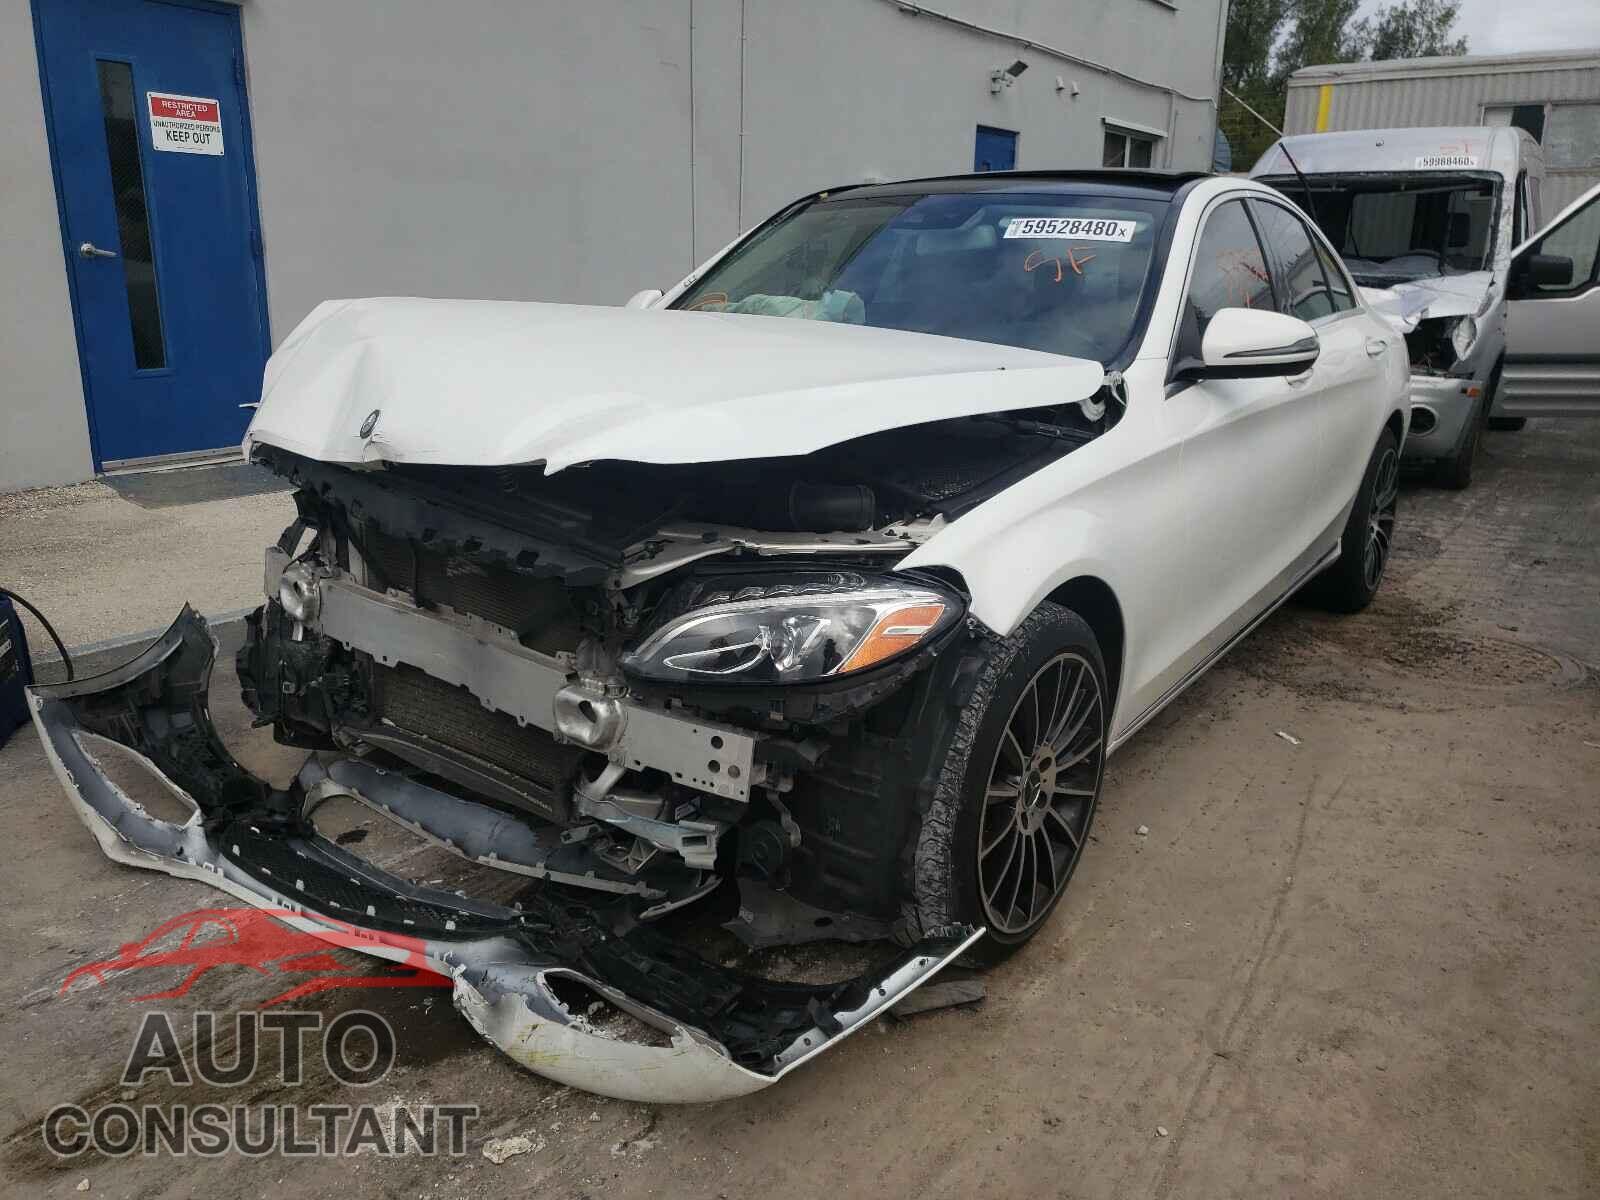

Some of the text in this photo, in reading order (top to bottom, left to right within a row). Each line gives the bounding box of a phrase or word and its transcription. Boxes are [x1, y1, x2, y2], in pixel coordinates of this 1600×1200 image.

[162, 101, 207, 112] RESTRICTED
[176, 109, 196, 118] AREA
[153, 121, 194, 131] UNAUTHORIZED
[166, 131, 210, 144] KEEP OUT
